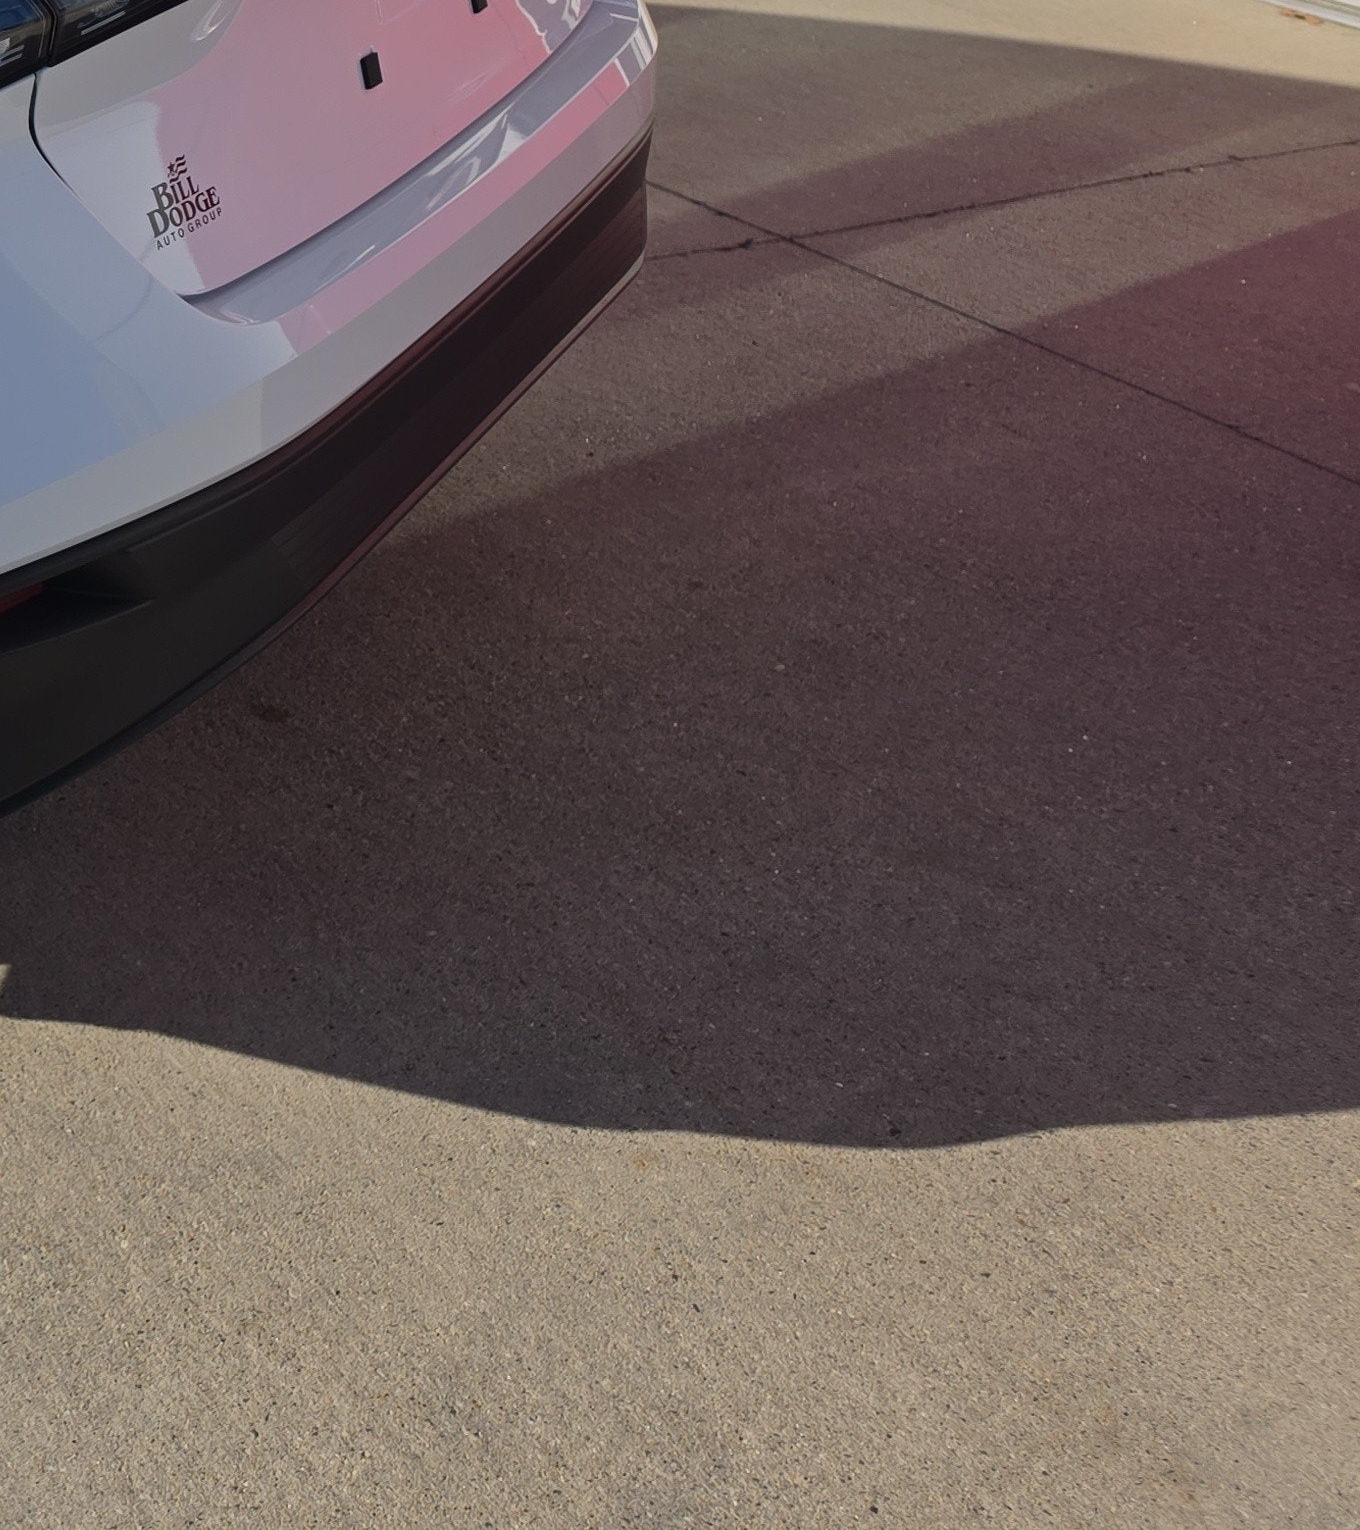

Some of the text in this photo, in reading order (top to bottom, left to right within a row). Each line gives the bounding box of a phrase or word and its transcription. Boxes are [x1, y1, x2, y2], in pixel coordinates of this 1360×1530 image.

[146, 186, 220, 238] DODGE
[151, 176, 199, 211] BILL
[156, 207, 222, 250] AUTO GROUP
